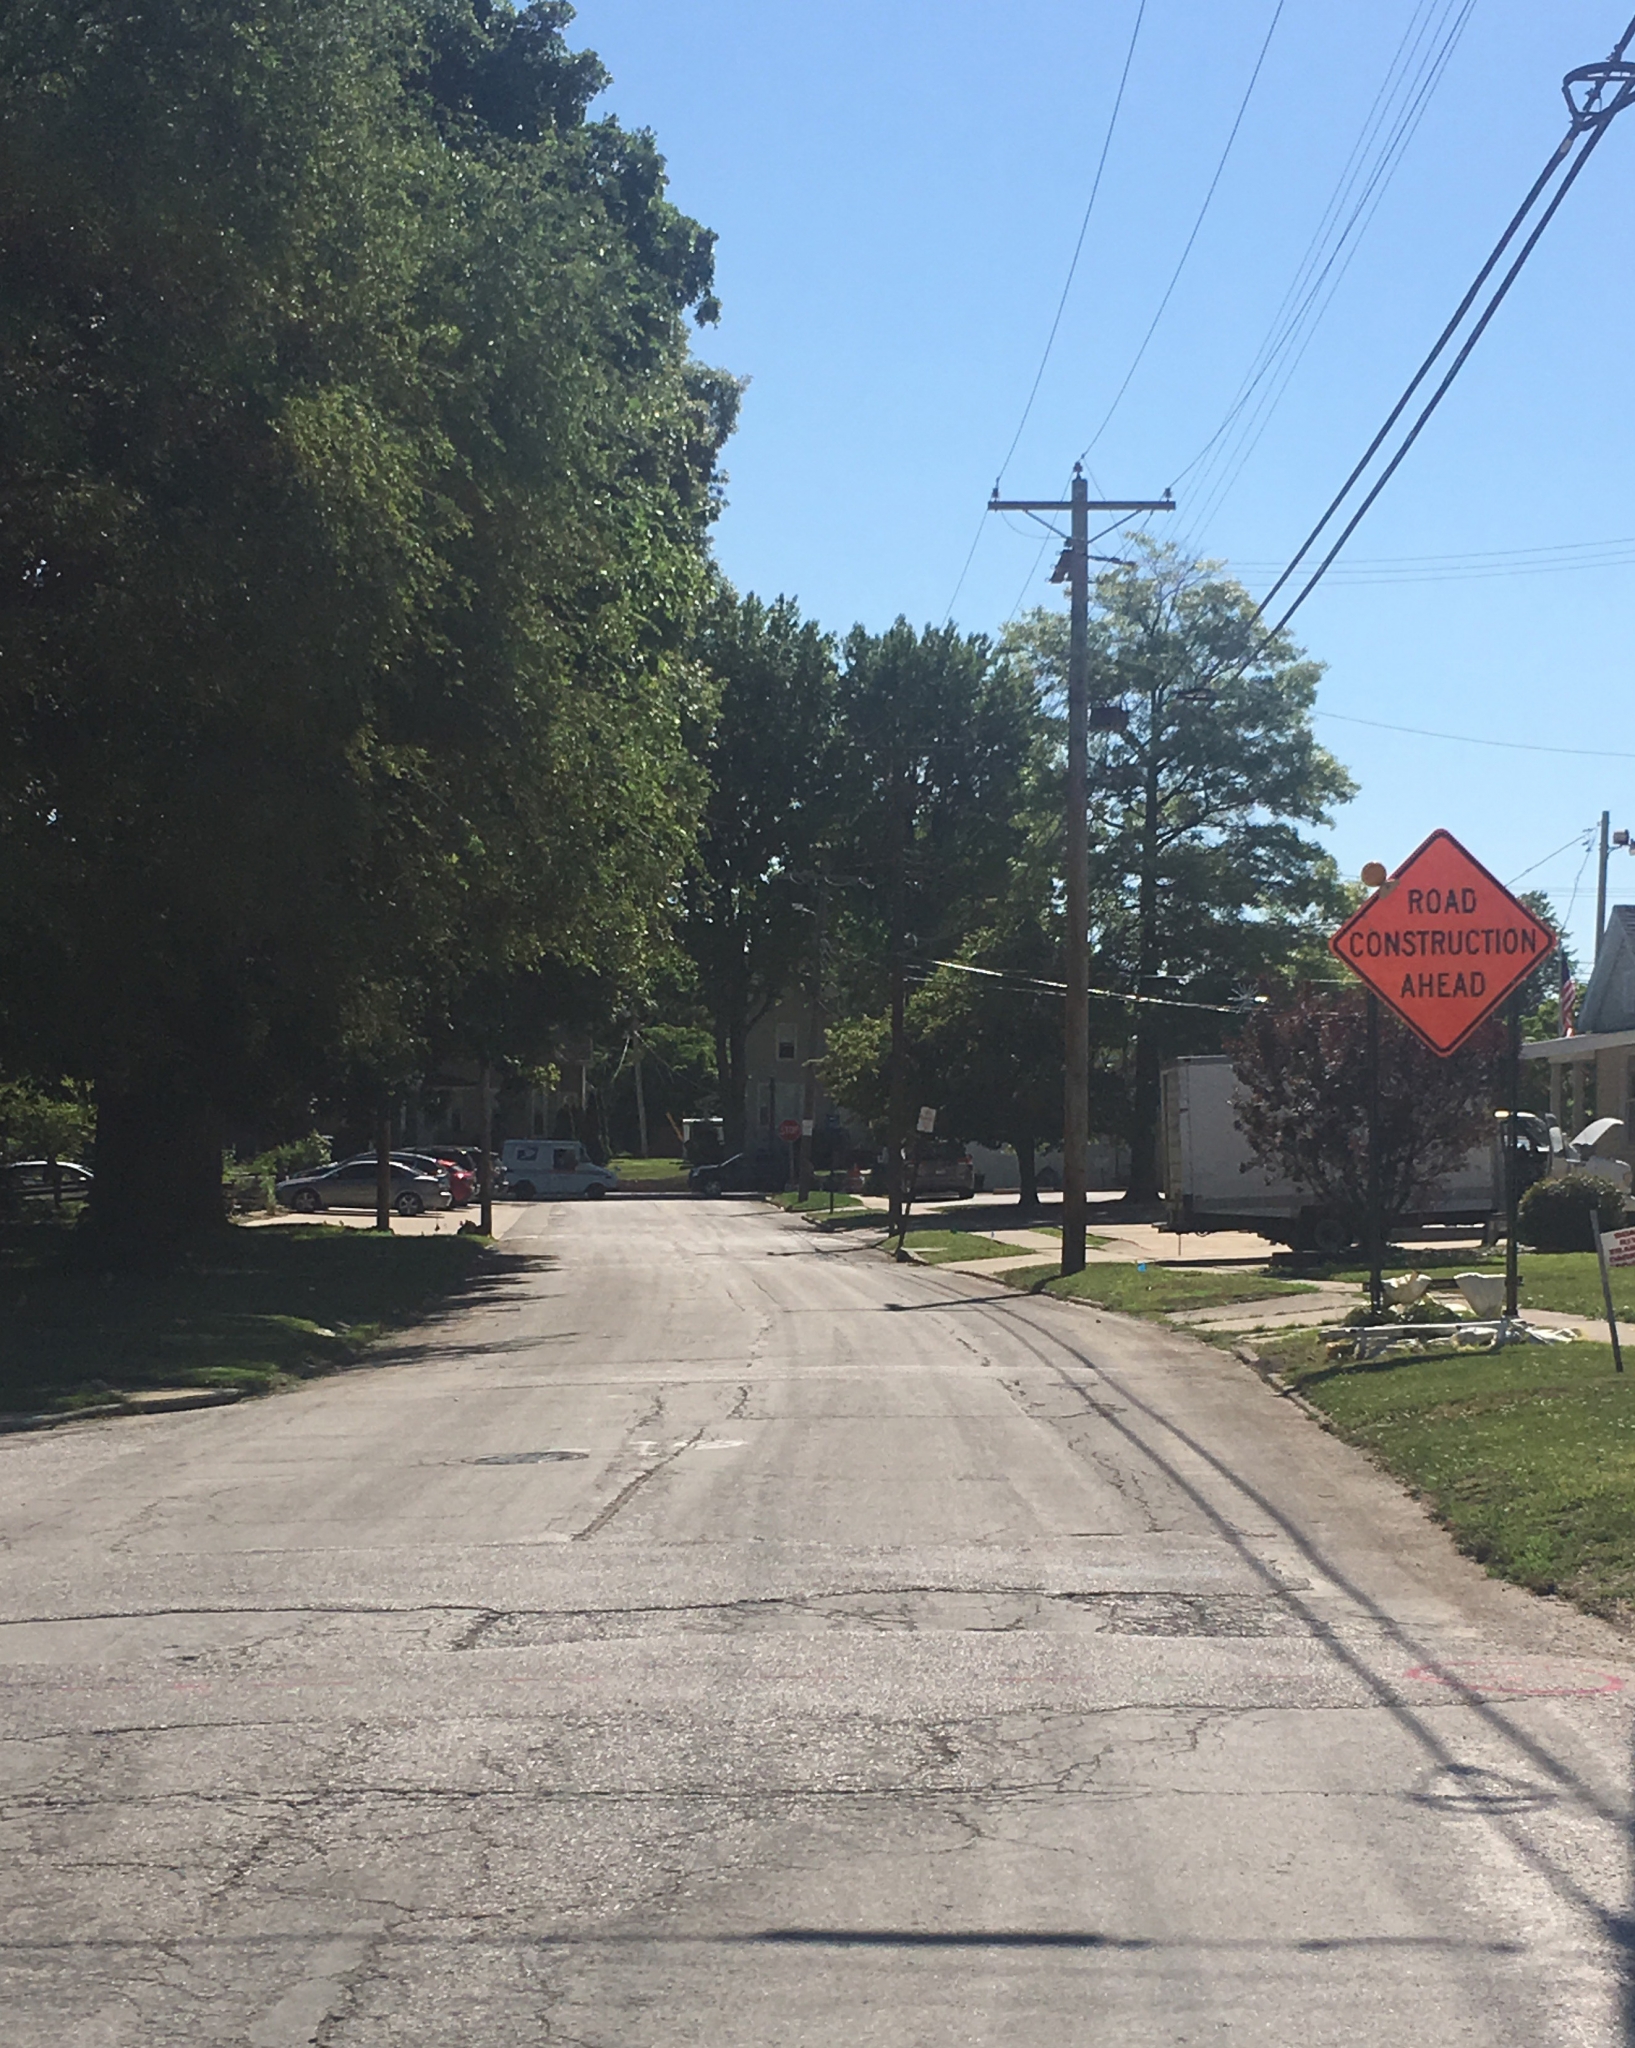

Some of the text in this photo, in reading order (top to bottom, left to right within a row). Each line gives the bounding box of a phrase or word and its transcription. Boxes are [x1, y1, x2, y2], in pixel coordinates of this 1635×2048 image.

[1407, 888, 1477, 914] ROAD
[1350, 928, 1537, 958] CONSTRUCTION
[1401, 971, 1486, 998] AHEAD
[779, 1125, 799, 1135] STOP
